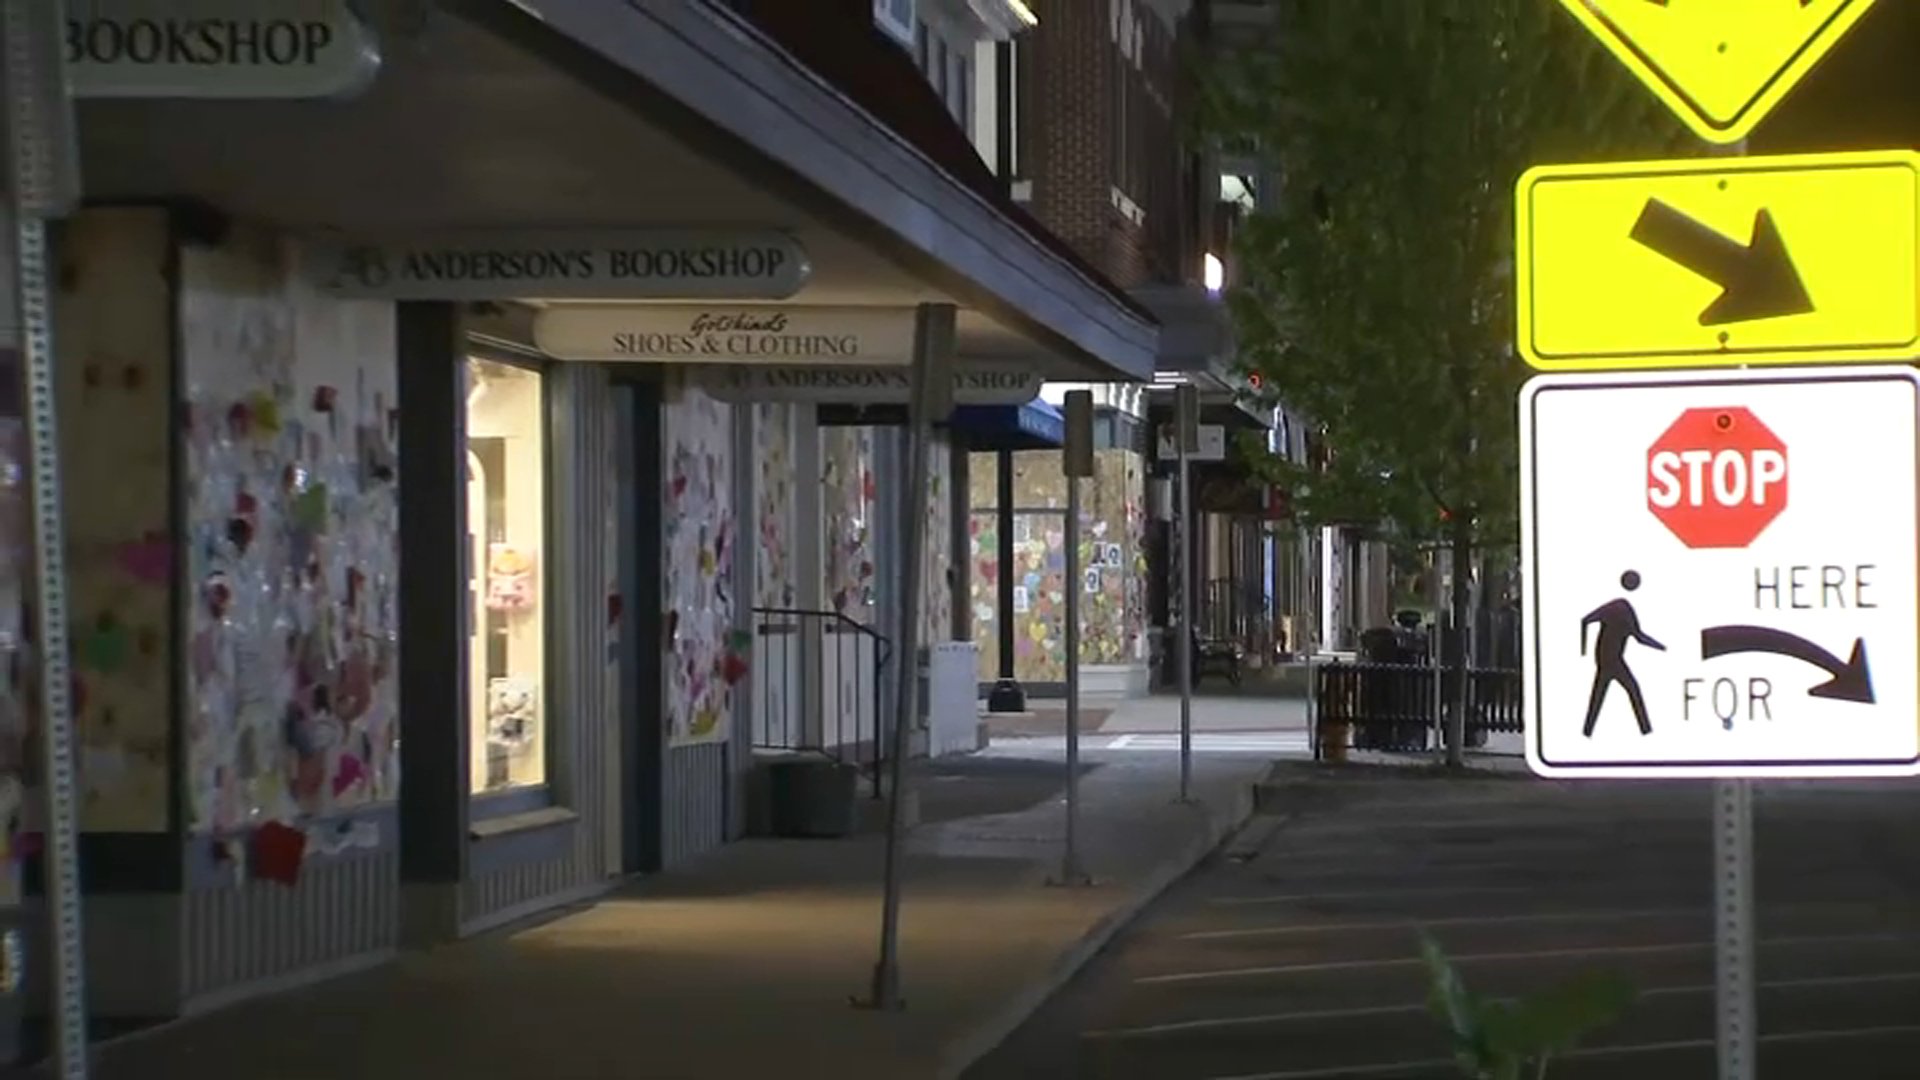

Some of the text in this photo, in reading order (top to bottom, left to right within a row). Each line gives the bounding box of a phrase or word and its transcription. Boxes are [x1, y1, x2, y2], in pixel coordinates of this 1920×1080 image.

[67, 19, 330, 64] BOOKSHOP
[405, 248, 784, 281] ANDERSON'S BOOKSHOP
[614, 334, 857, 355] SHOES & CLOTHING
[953, 372, 1030, 389] YSHOP
[1648, 449, 1786, 507] STOP
[1754, 565, 1878, 609] HERE
[1683, 677, 1773, 721] FOR
